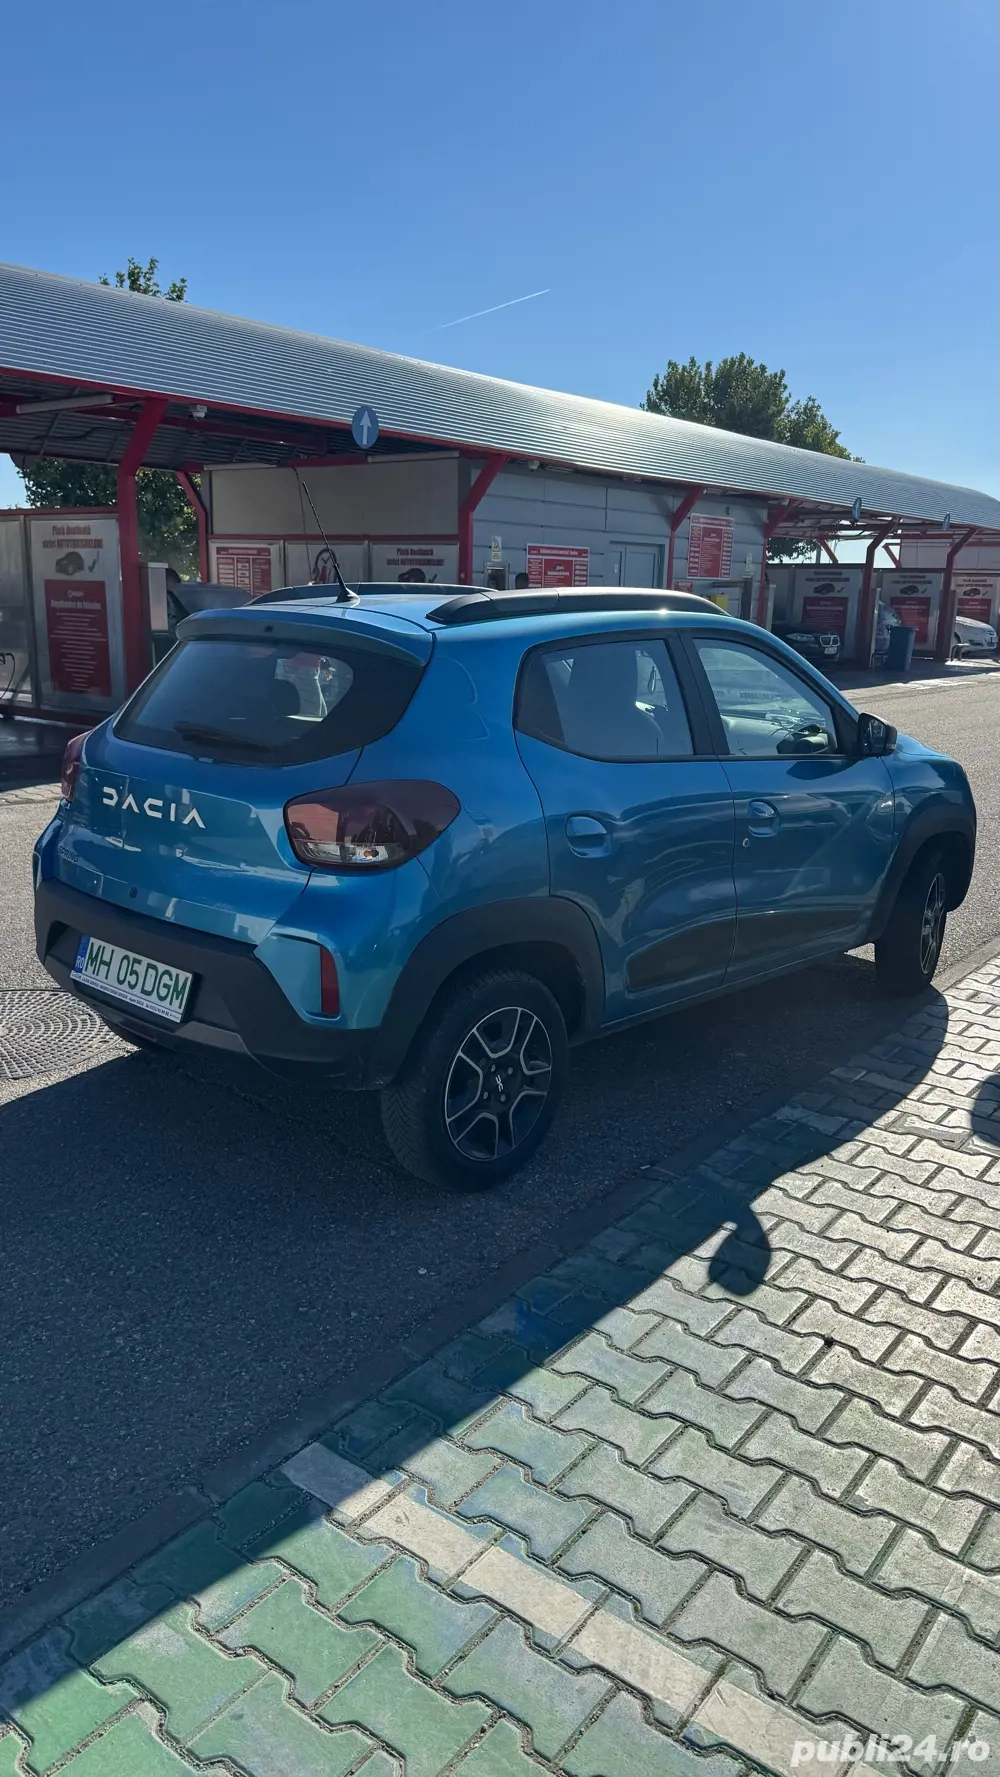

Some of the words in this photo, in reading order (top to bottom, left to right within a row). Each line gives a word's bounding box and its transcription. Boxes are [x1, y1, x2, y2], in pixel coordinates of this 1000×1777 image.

[102, 786, 206, 829] DACIA
[58, 845, 79, 862] SPRING
[75, 956, 85, 969] RO
